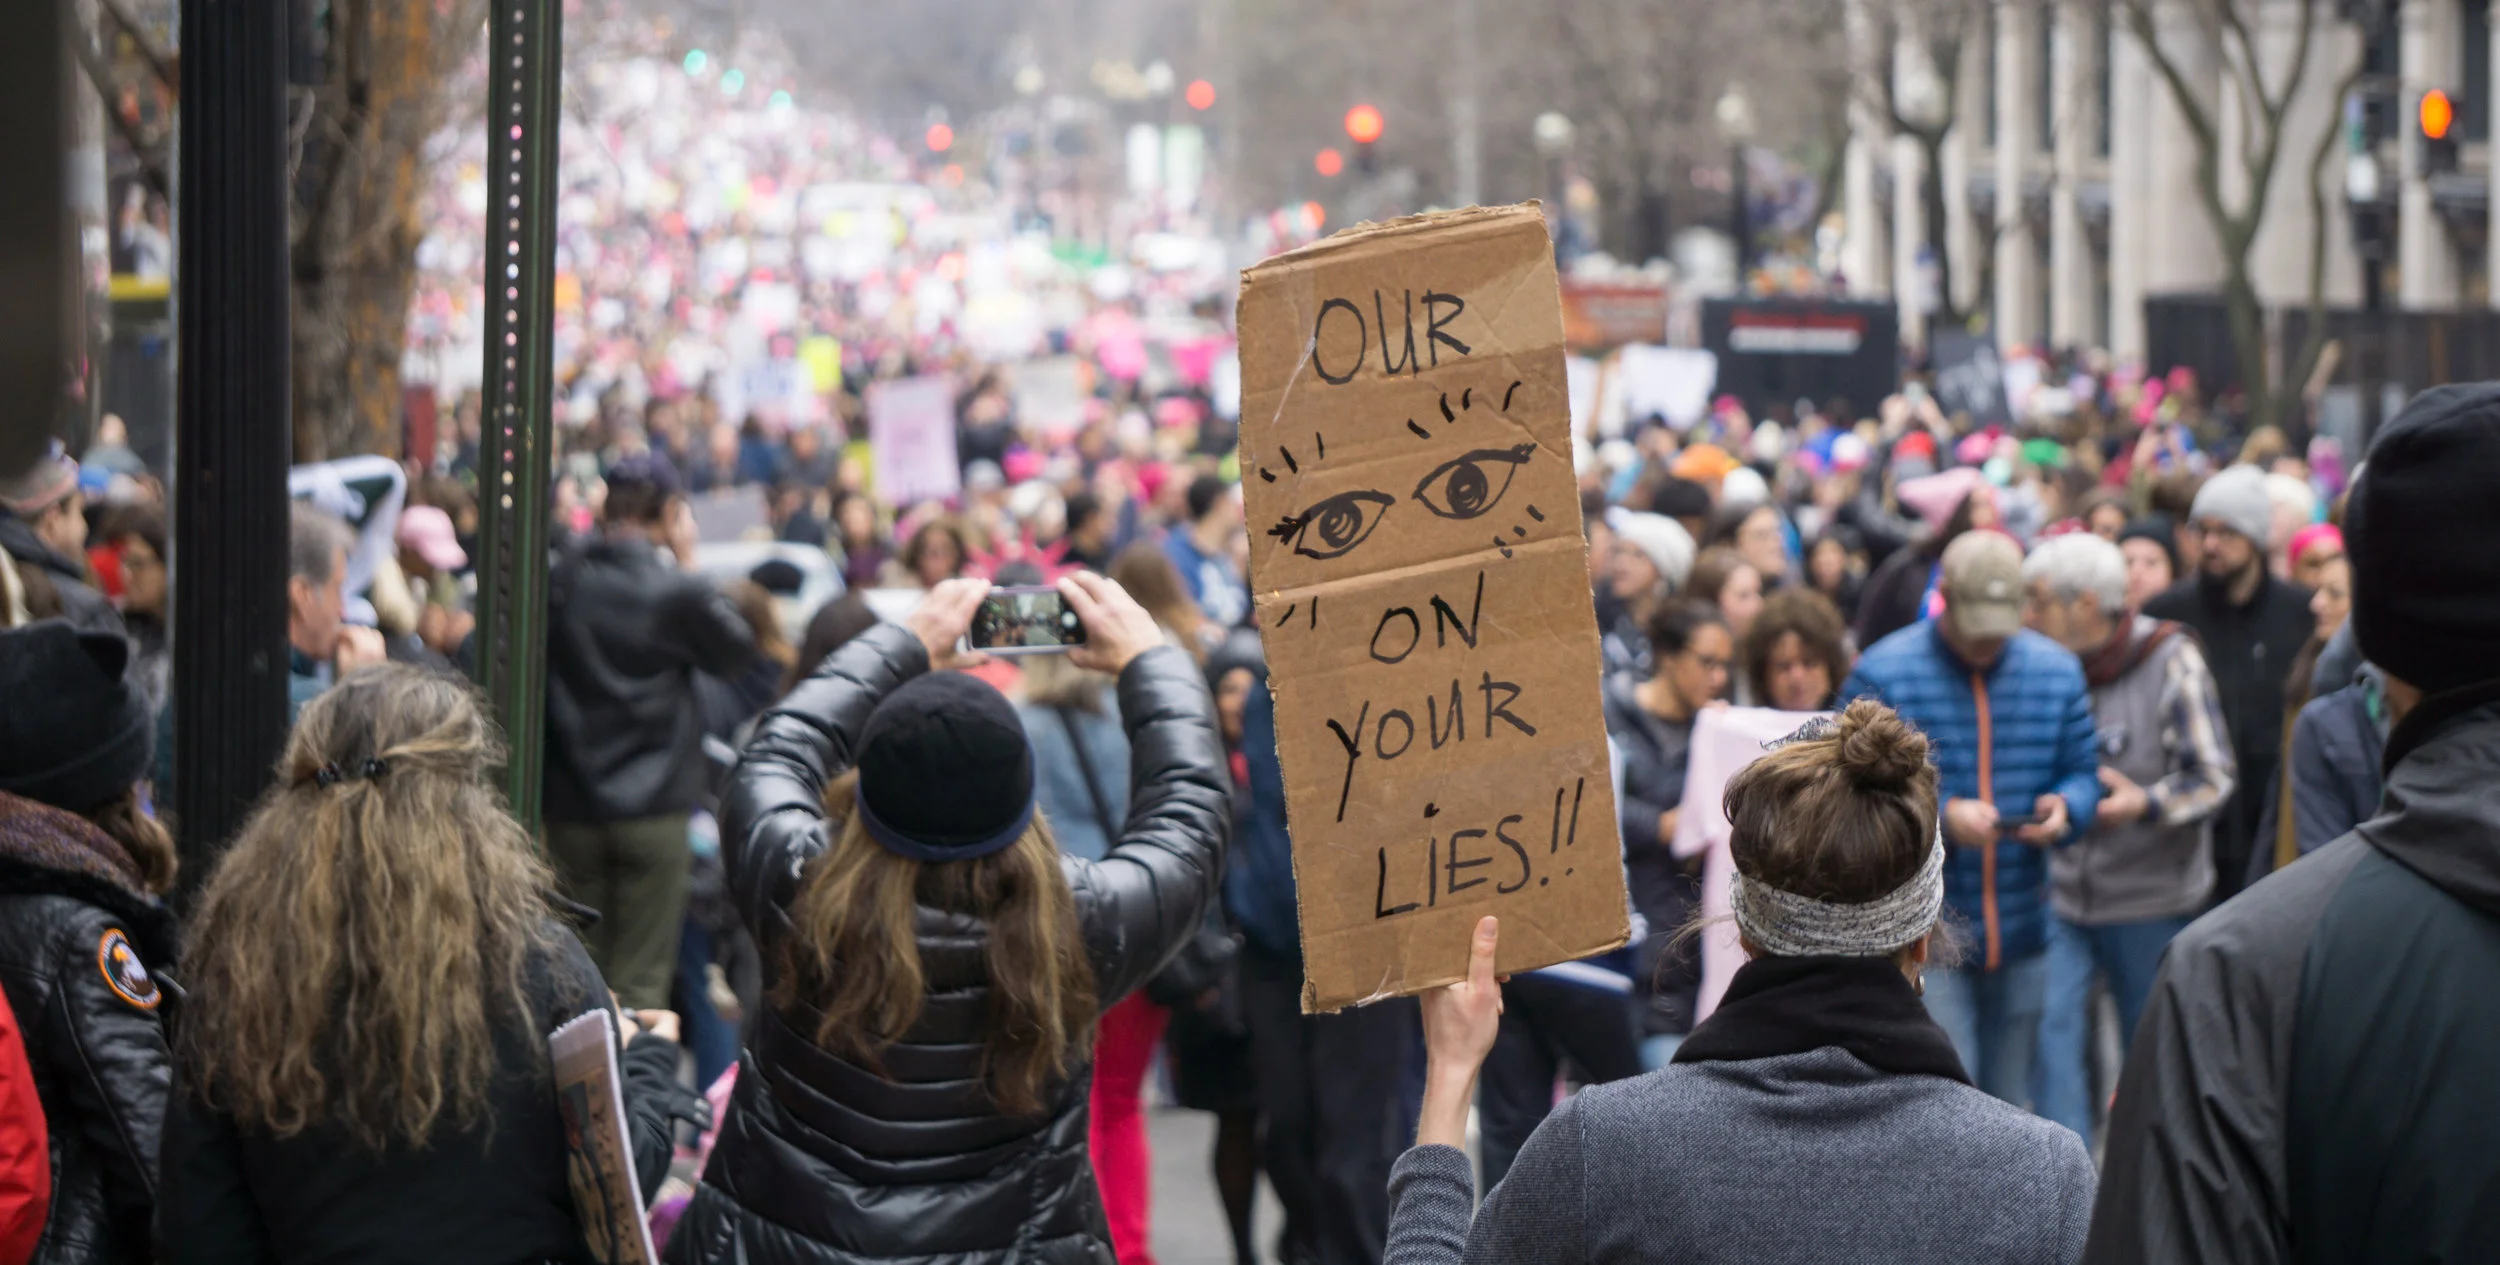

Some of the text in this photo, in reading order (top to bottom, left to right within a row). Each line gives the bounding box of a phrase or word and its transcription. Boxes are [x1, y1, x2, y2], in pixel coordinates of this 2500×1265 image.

[1312, 289, 1471, 385] OUR
[1369, 570, 1485, 665] ON
[1325, 671, 1537, 823] YOUR
